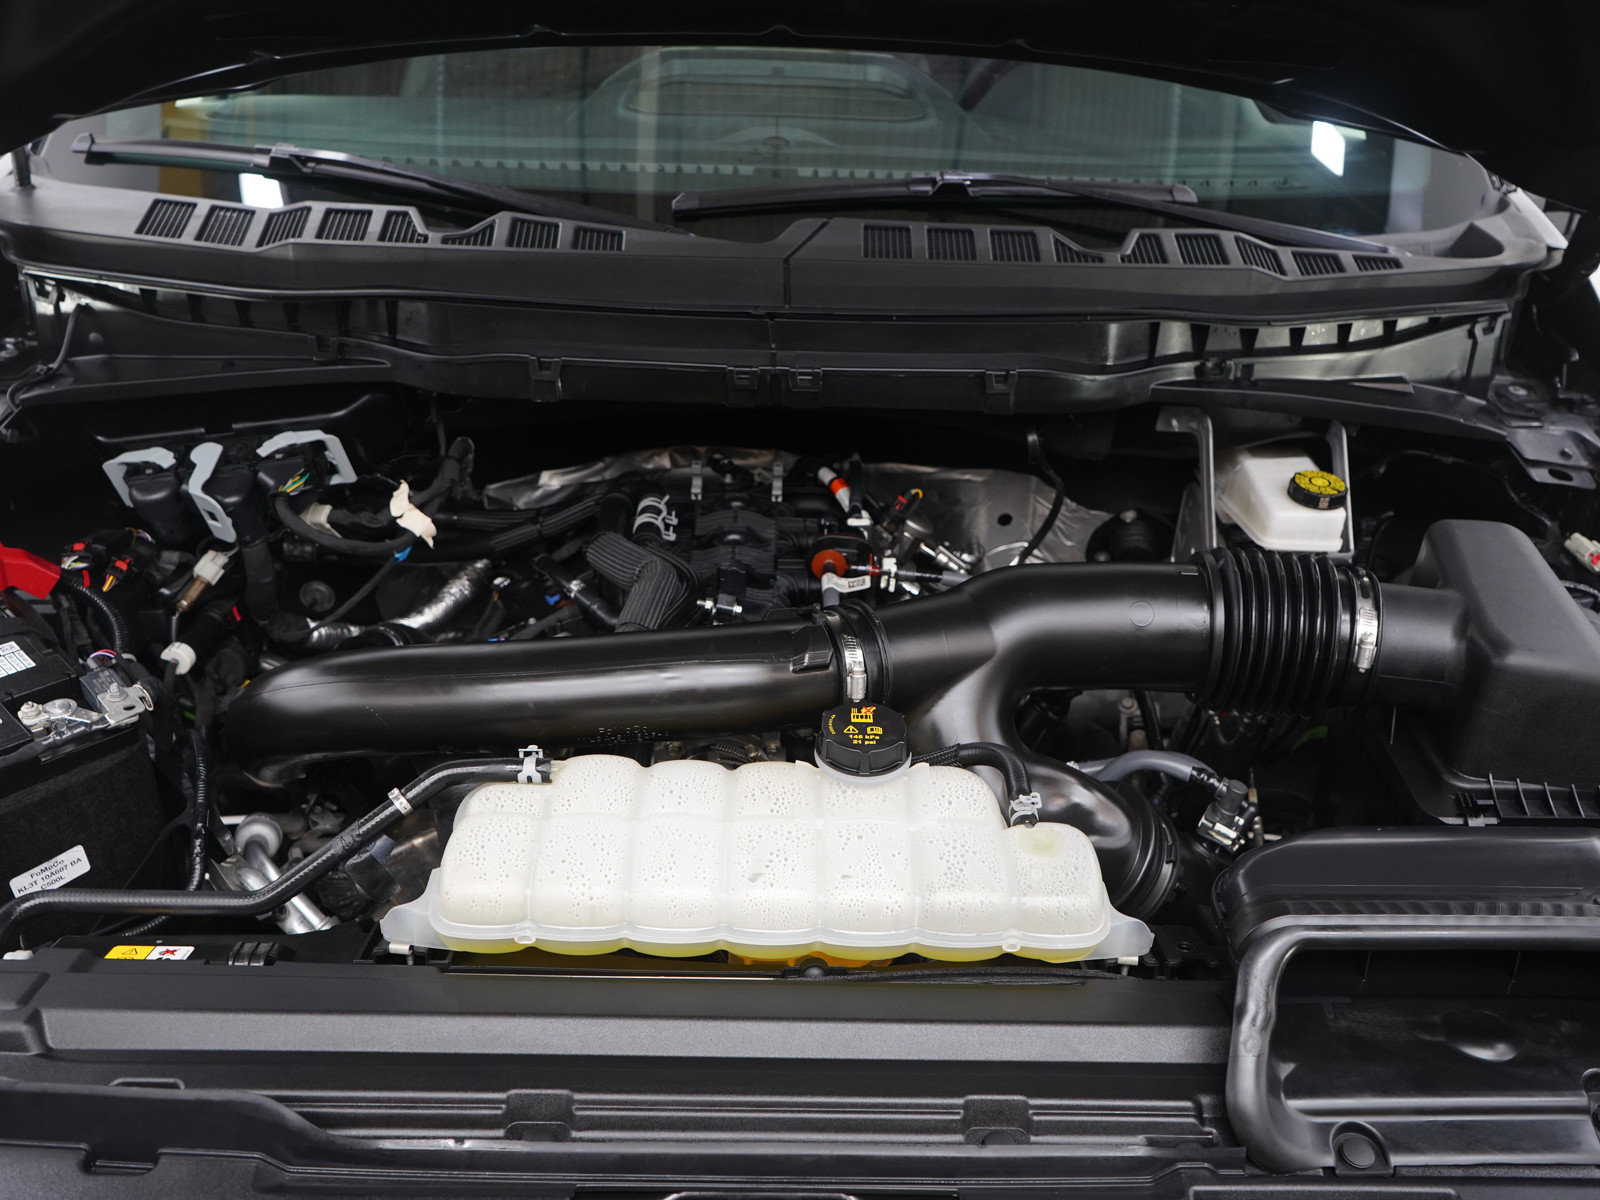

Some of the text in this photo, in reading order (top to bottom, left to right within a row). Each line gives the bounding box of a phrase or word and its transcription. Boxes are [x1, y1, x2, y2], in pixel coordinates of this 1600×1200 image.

[17, 880, 39, 894] KL3T
[70, 857, 82, 867] BA
[30, 859, 65, 879] FoMoCo
